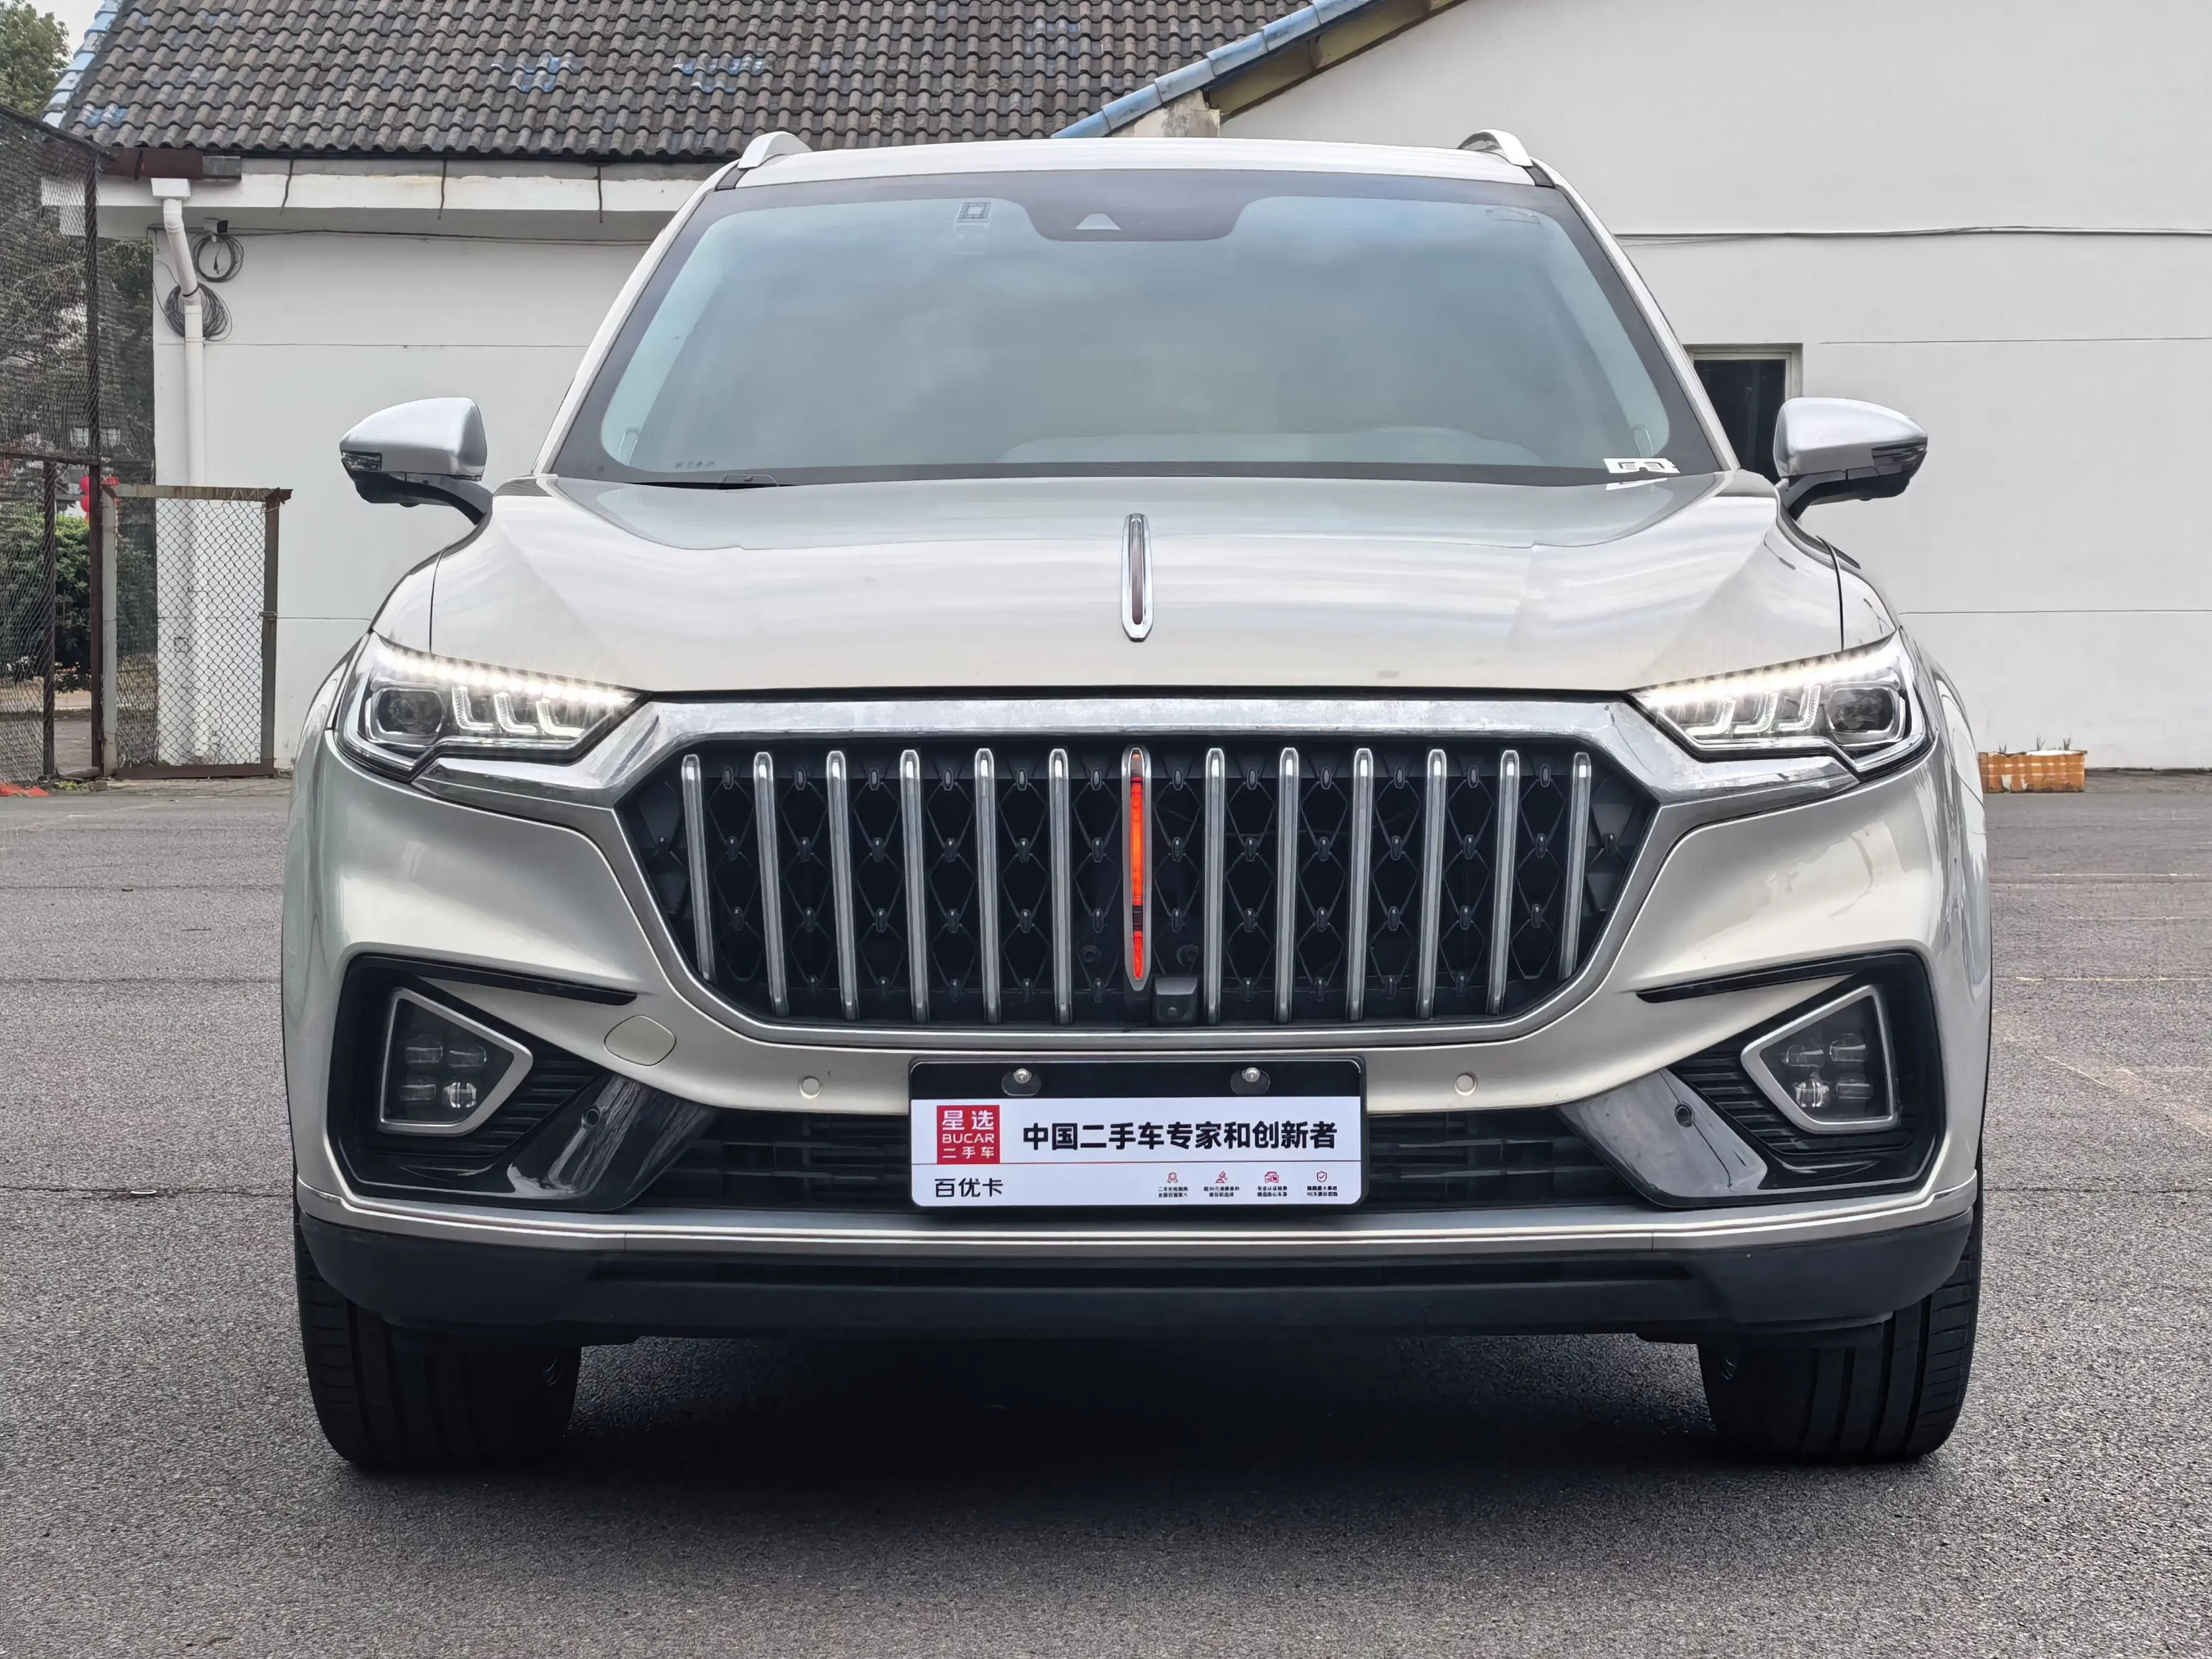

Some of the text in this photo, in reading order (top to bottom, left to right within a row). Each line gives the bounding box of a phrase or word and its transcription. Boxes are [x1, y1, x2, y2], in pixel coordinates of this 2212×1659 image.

[942, 1110, 994, 1130] 星选
[942, 1133, 995, 1144] BUCAR
[1023, 1121, 1337, 1150] 中国二手车专家和创新者
[942, 1146, 995, 1159] 二手车
[934, 1177, 1003, 1197] 百优卡
